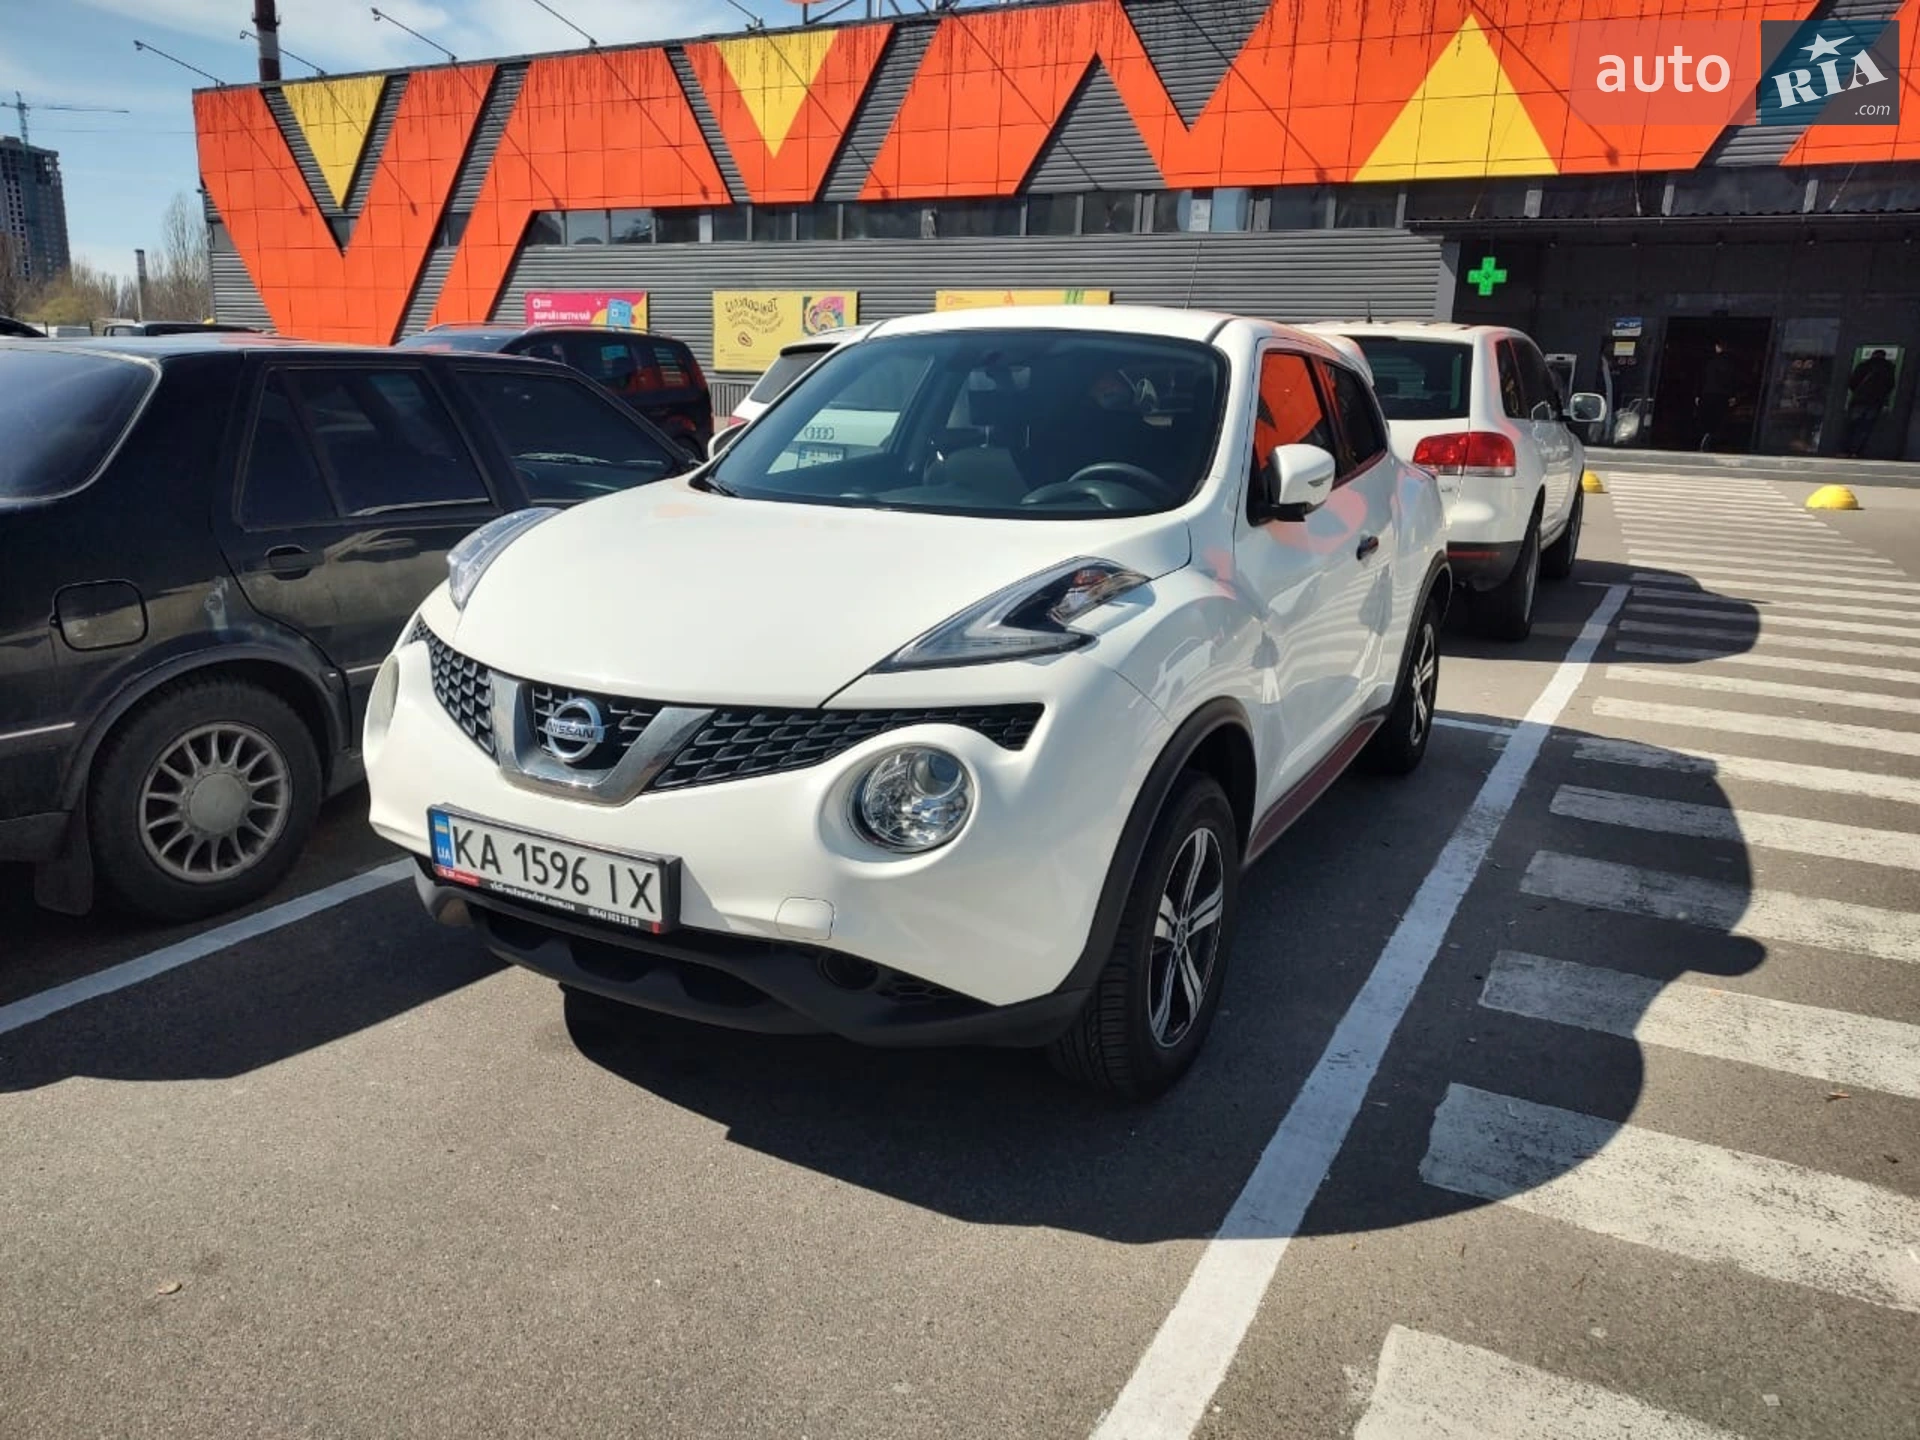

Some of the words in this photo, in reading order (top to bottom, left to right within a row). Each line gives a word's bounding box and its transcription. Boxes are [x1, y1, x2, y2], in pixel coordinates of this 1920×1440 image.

[547, 721, 594, 739] NISSAN
[437, 845, 451, 861] UA
[453, 826, 502, 874] KA
[513, 842, 589, 895] 1596
[609, 864, 655, 912] IX
